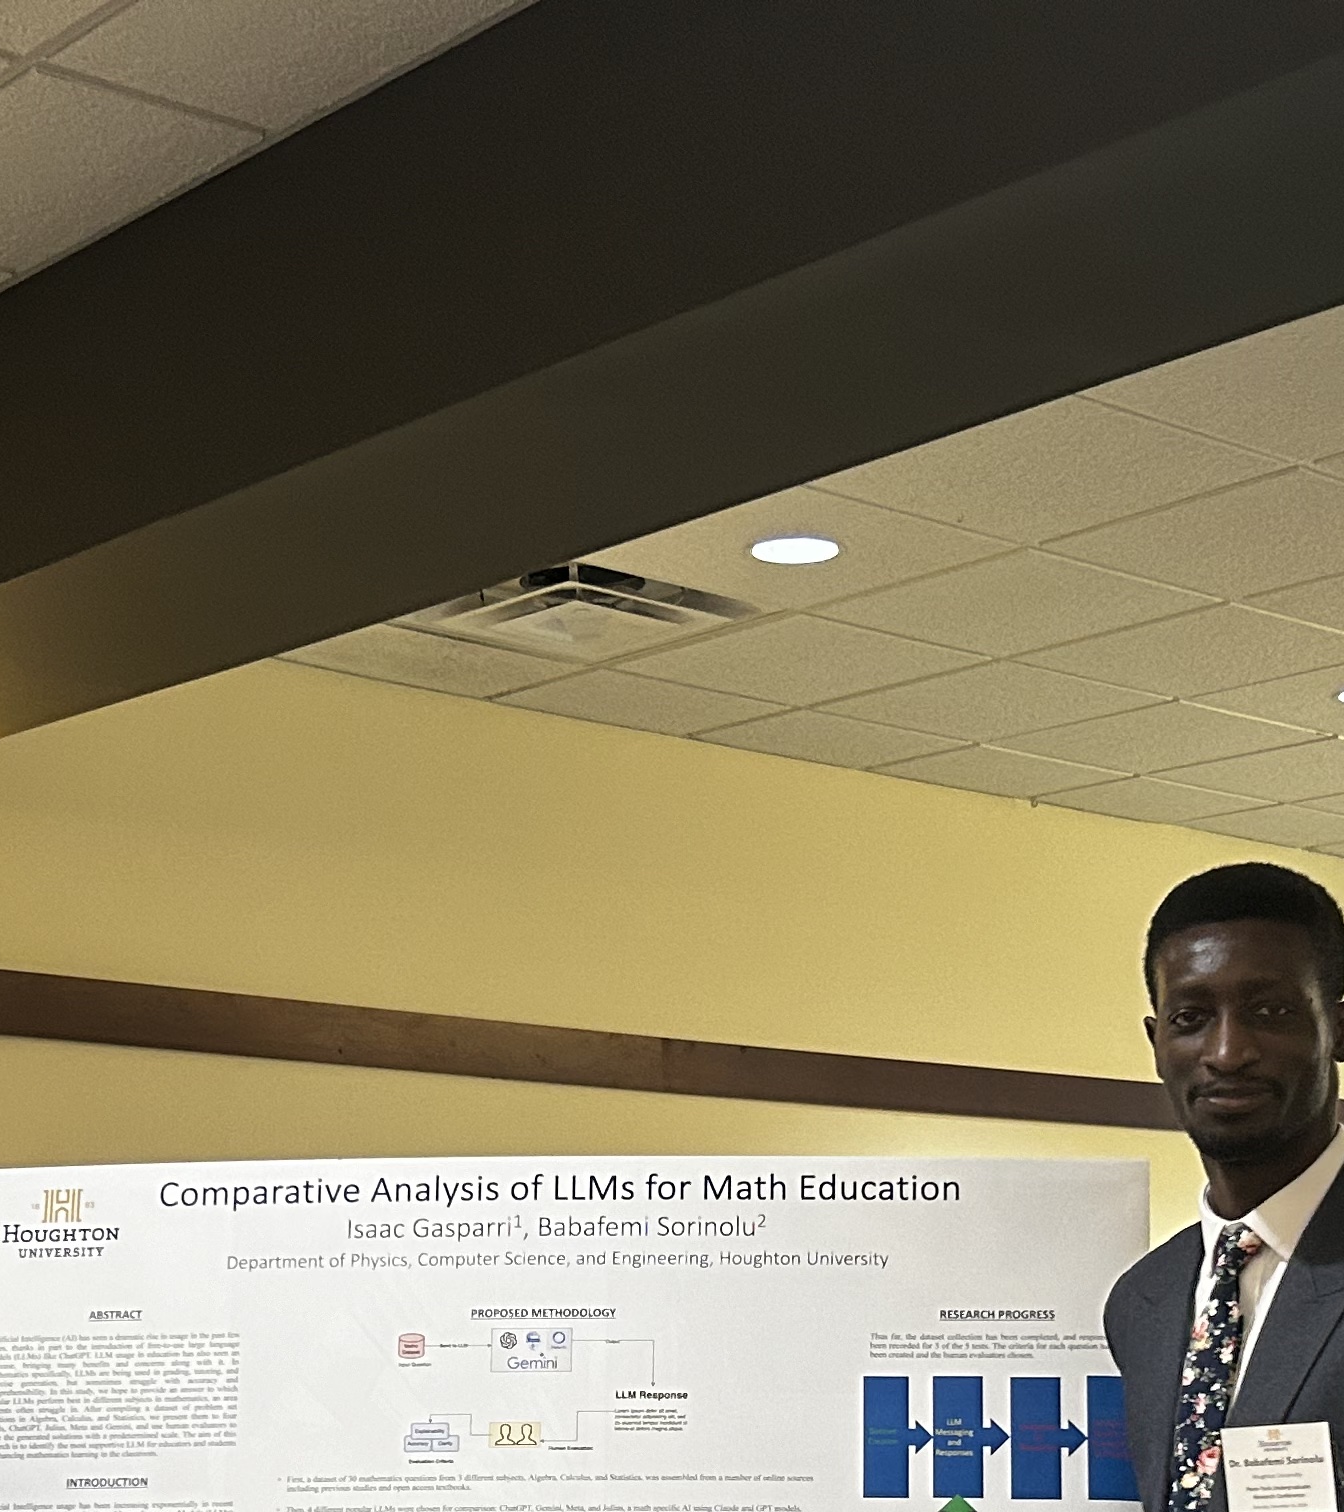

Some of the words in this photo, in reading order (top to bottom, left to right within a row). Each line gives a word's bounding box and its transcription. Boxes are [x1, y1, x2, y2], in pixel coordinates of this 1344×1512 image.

[161, 1178, 359, 1212] Comparative
[371, 1174, 498, 1209] Analysis
[511, 1173, 543, 1200] of
[555, 1174, 634, 1201] LLMs
[646, 1173, 691, 1201] for
[704, 1172, 786, 1201] Math
[801, 1172, 959, 1202] Education
[348, 1219, 404, 1239] Isaac
[539, 1215, 648, 1237] Babafemi
[2, 1224, 120, 1243] HOUGHTON
[18, 1247, 104, 1258] UNIVERSITY
[228, 1255, 323, 1271] Department
[330, 1253, 345, 1268] of
[352, 1252, 411, 1270] Physics,
[418, 1252, 499, 1269] Computer
[505, 1250, 570, 1268] Science,
[577, 1252, 605, 1265] and
[613, 1251, 713, 1269] Engineering,
[720, 1250, 800, 1269] Houghton
[808, 1250, 888, 1270] University
[89, 1310, 142, 1322] ABSTRACT
[471, 1309, 528, 1320] PROPOSED
[532, 1309, 616, 1319] METHODOLOGY
[940, 1310, 995, 1320] RESEARCH
[998, 1310, 1055, 1320] PROGRESS
[507, 1357, 558, 1369] Gemini
[616, 1391, 636, 1399] LLM
[640, 1391, 688, 1401] Response
[946, 1418, 963, 1426] LLM
[935, 1428, 974, 1438] Messaging
[947, 1439, 962, 1447] and
[935, 1448, 974, 1458] Responses
[66, 1477, 148, 1489] INTRODUCTION
